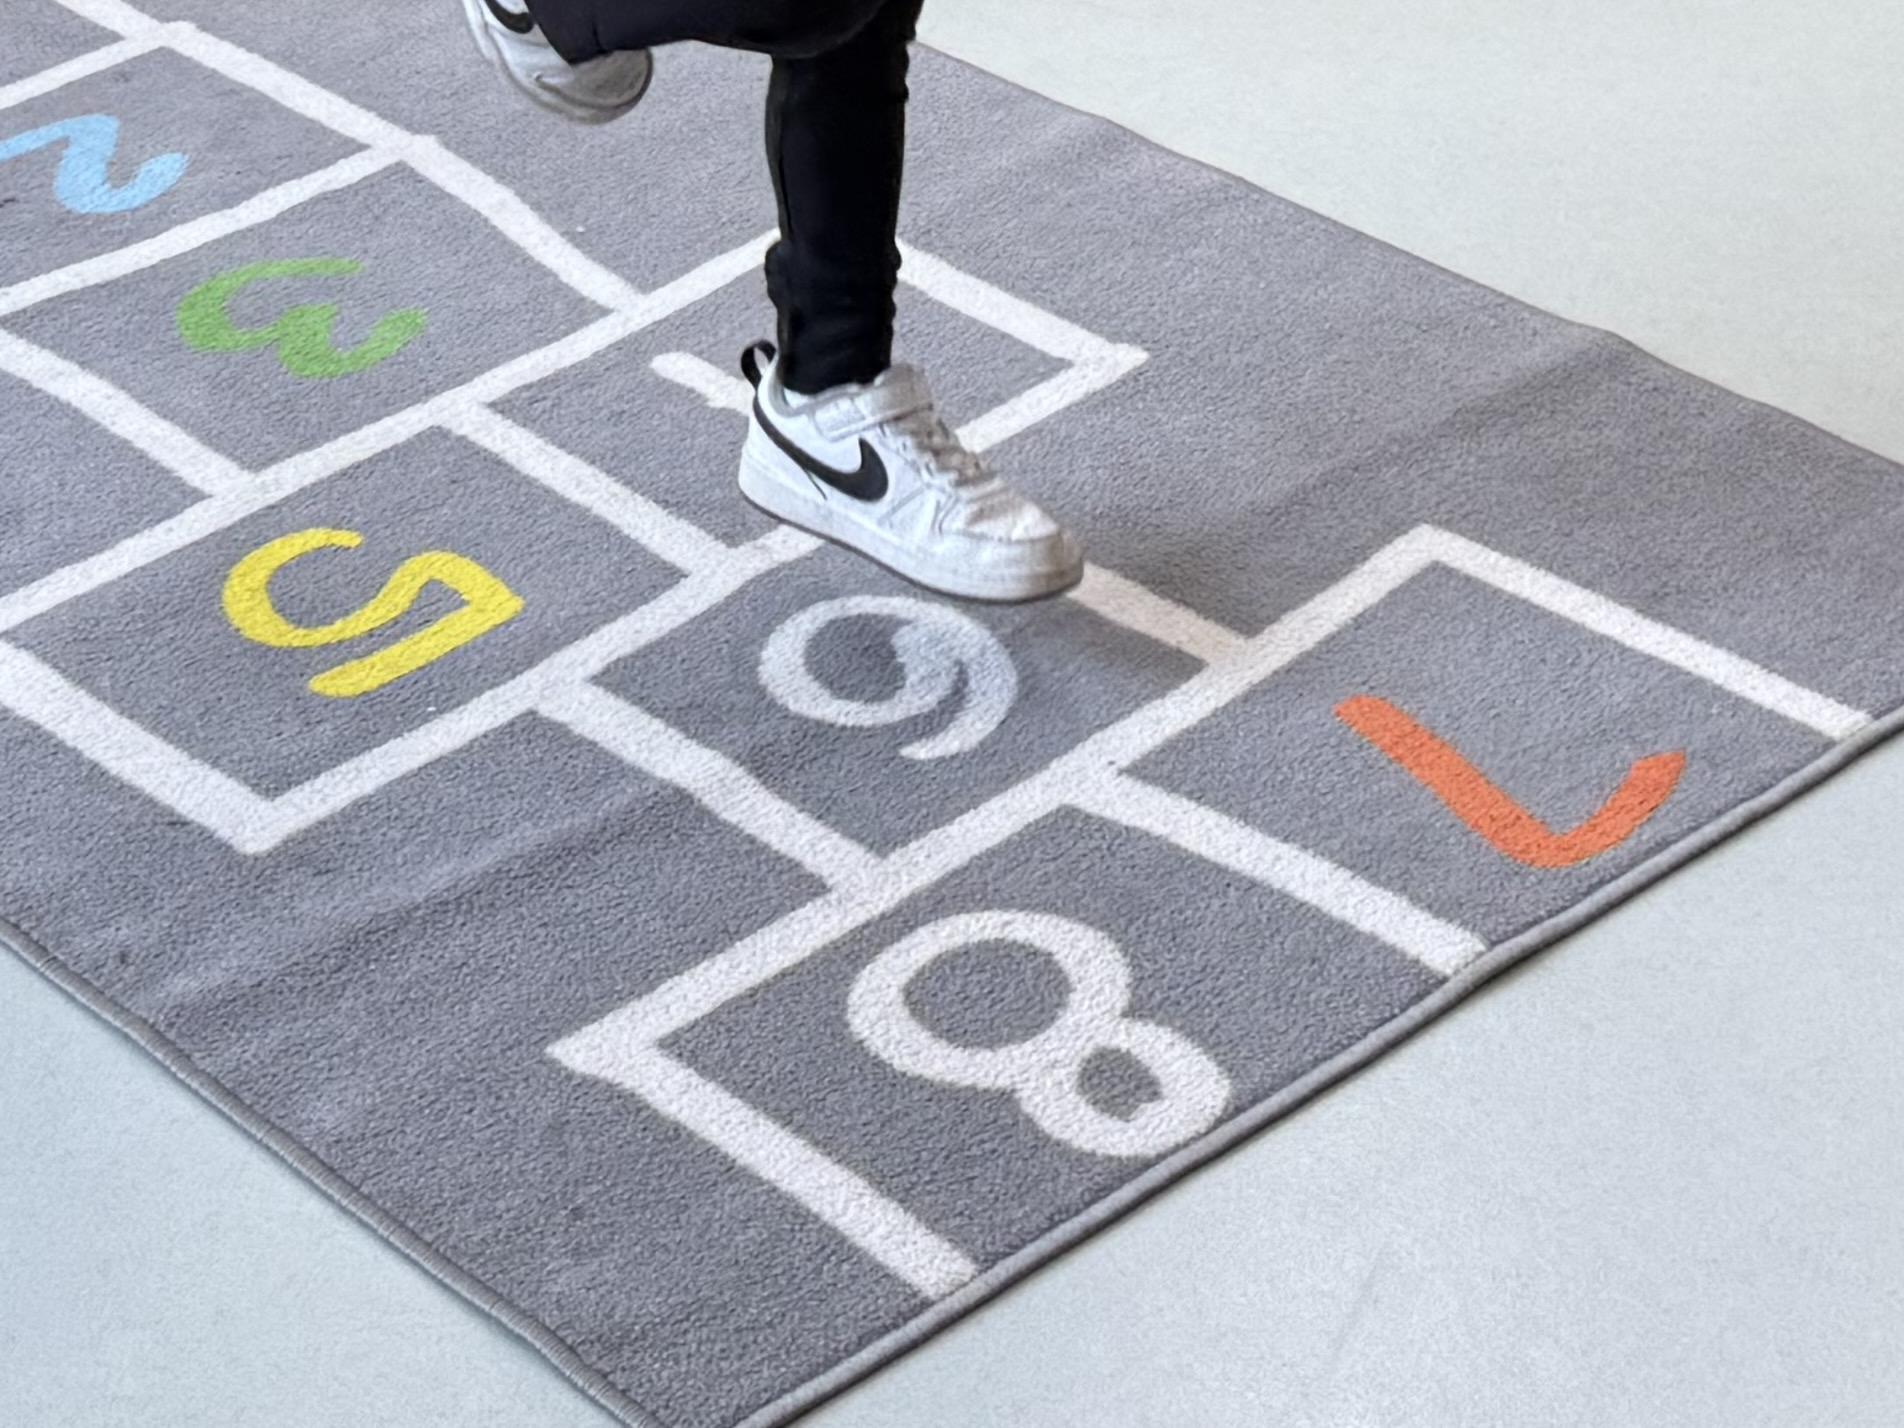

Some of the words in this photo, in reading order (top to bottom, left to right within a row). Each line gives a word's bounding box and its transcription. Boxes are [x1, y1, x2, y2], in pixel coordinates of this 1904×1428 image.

[177, 258, 428, 378] 3
[222, 528, 525, 698] 5
[1334, 694, 1687, 869] 7
[845, 908, 1234, 1158] 8
